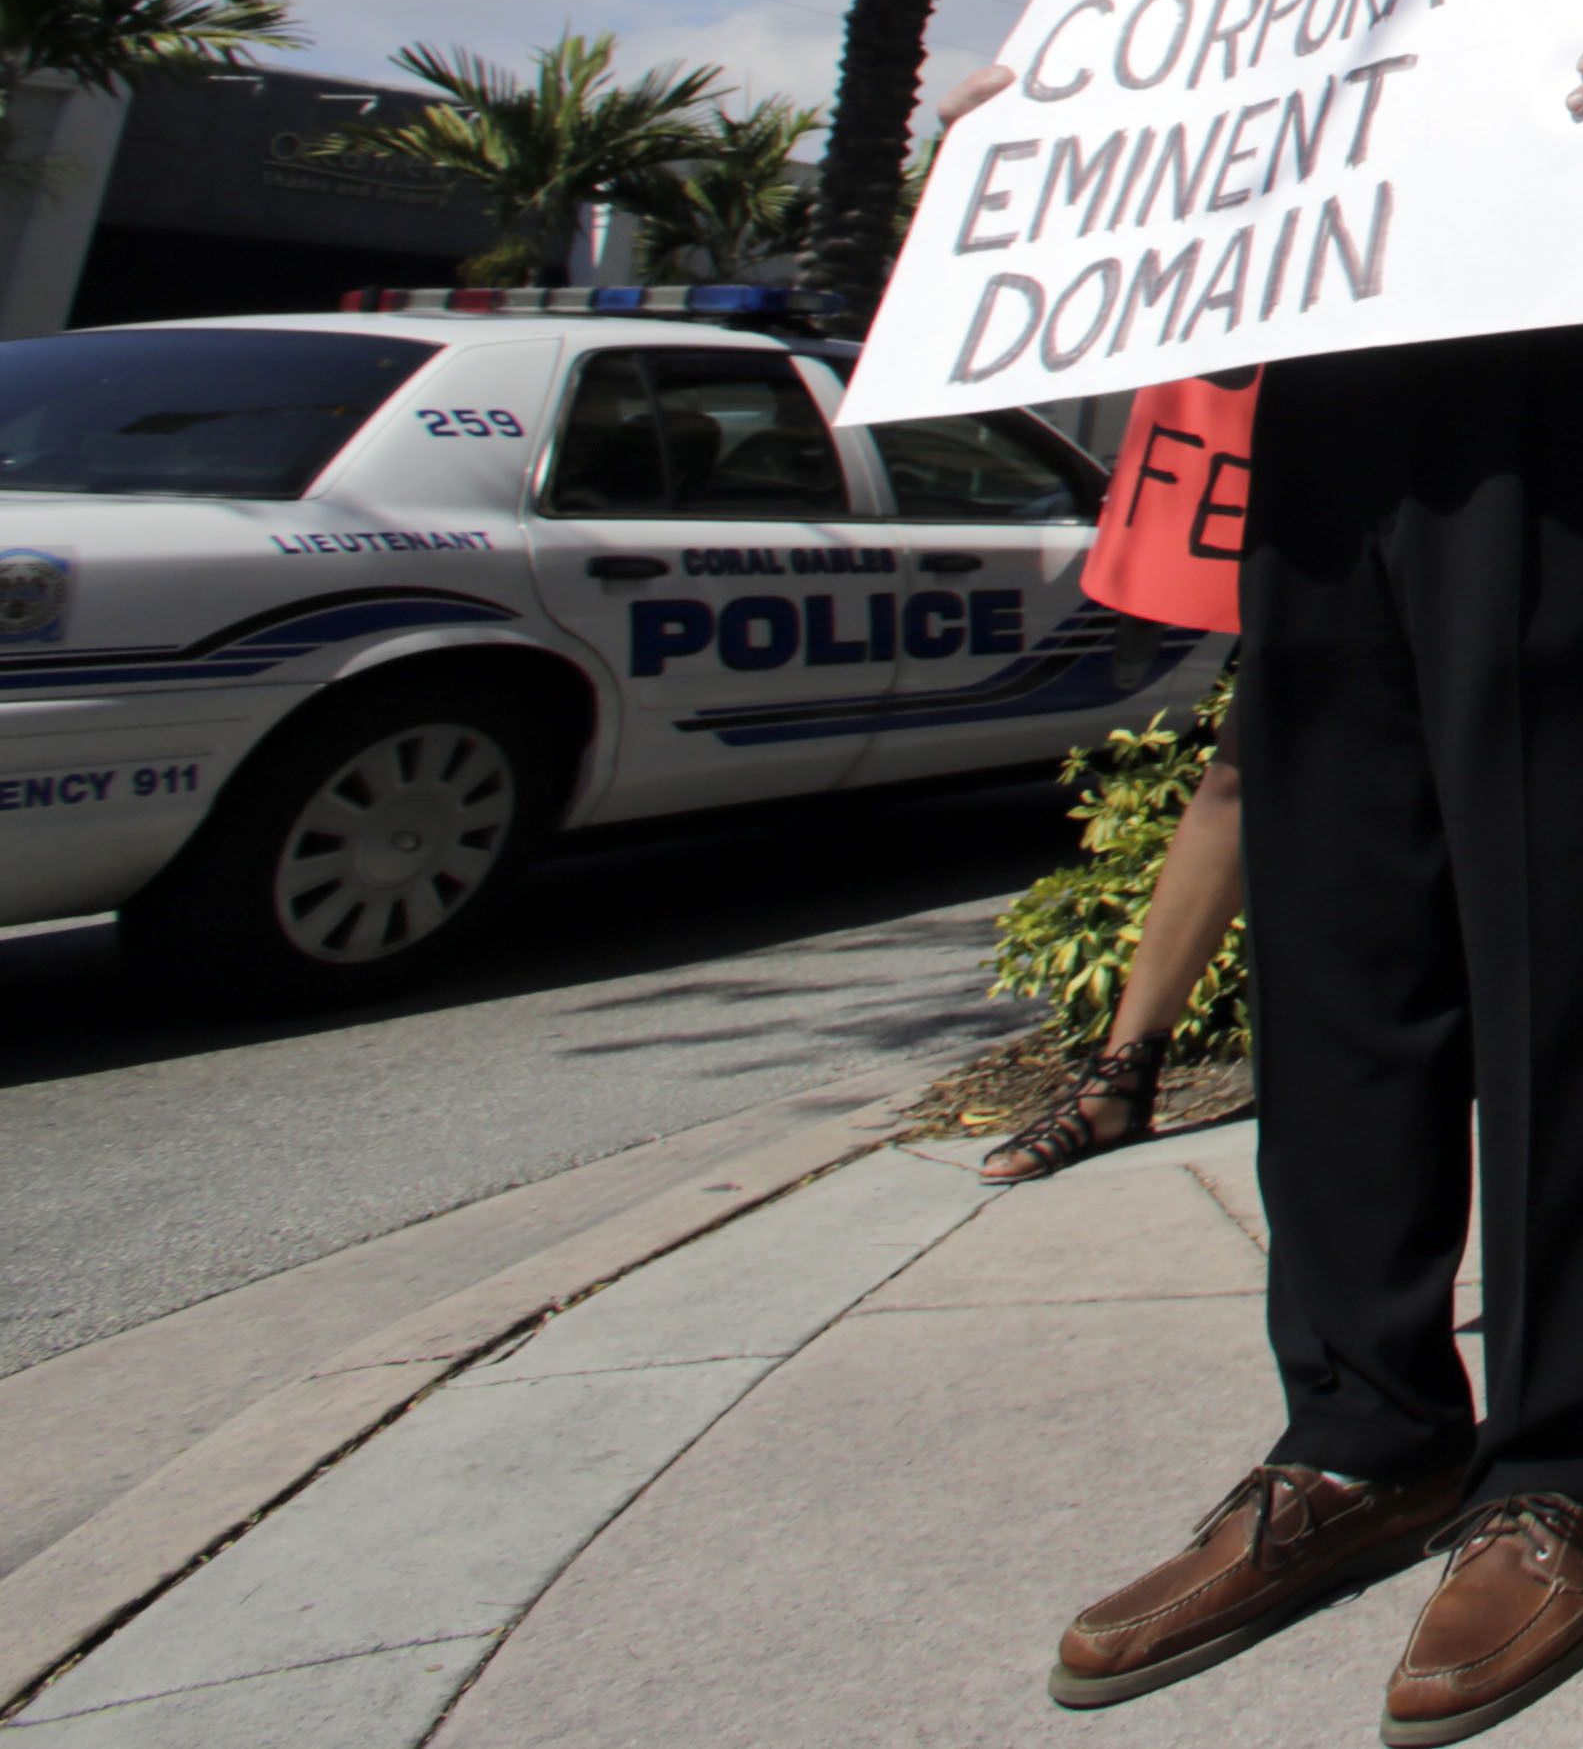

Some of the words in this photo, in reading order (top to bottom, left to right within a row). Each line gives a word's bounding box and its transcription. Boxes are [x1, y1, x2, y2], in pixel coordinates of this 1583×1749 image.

[954, 54, 1418, 256] EMINENT
[947, 179, 1395, 386] DOMAIN
[416, 409, 525, 438] 259
[1125, 422, 1250, 562] FE
[269, 531, 494, 555] LIEUTENANT
[628, 588, 1025, 678] POLICE
[0, 770, 116, 812] ENCY
[132, 763, 200, 797] 911
